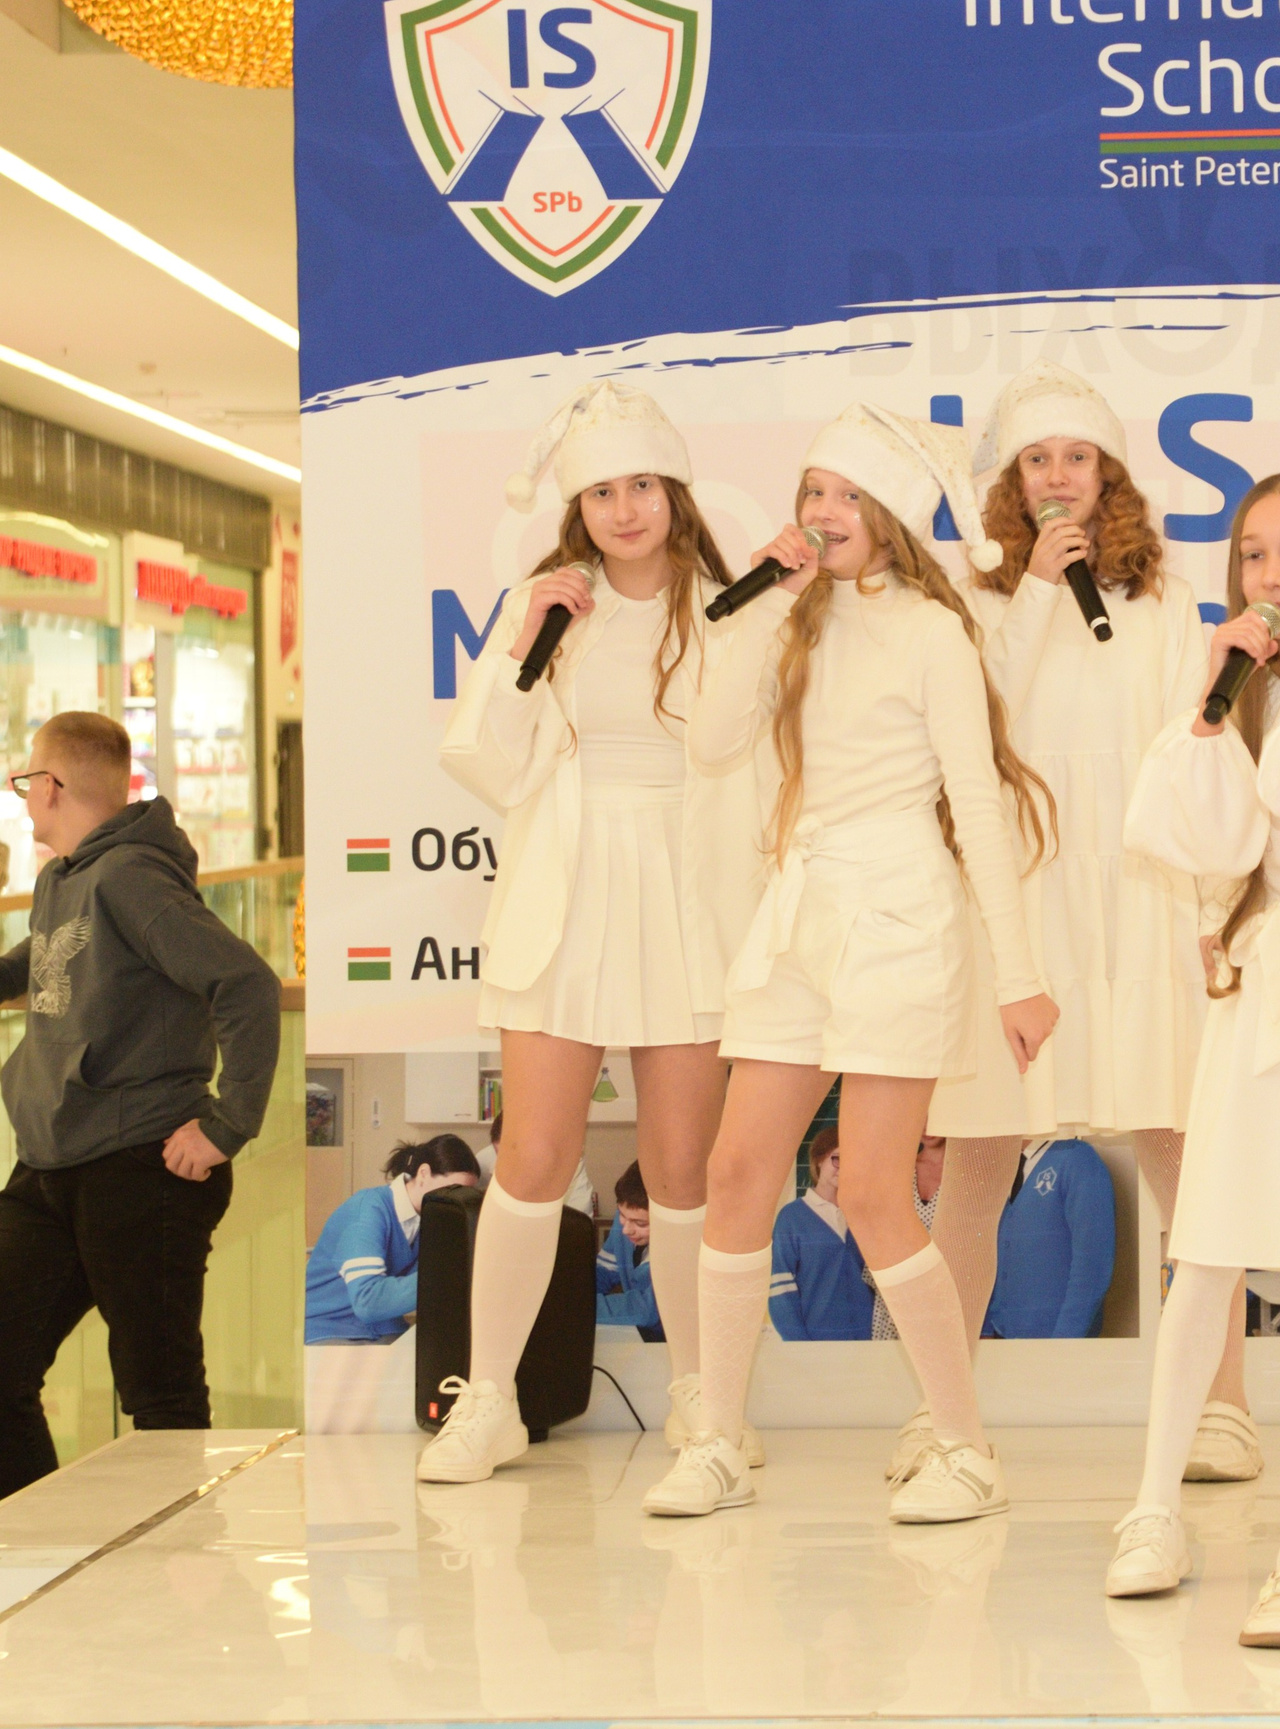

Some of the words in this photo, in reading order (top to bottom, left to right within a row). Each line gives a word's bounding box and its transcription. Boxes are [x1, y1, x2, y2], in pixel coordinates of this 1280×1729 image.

[506, 7, 597, 89] IS
[1100, 157, 1185, 189] Saint
[532, 191, 583, 214] SPb
